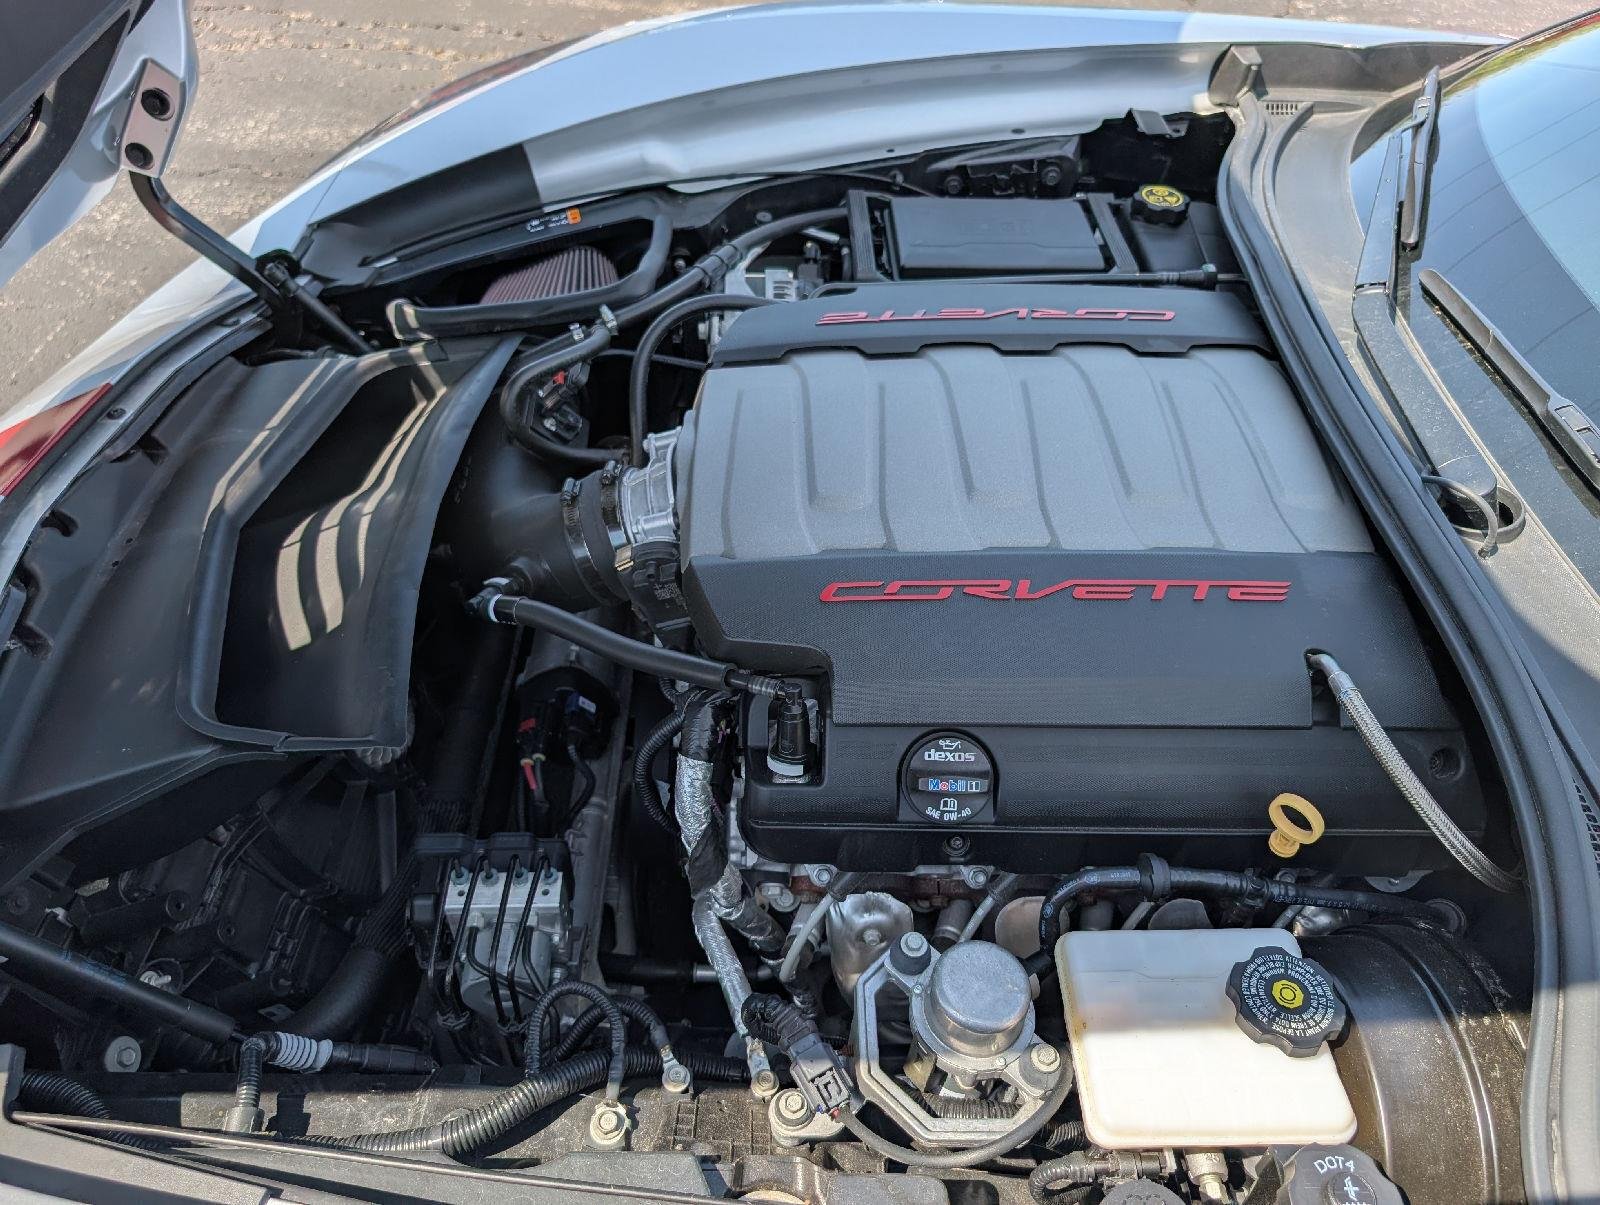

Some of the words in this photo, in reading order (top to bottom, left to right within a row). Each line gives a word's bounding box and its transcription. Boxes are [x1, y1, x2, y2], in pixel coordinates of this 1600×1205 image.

[815, 308, 1177, 325] CORVETTE
[819, 579, 1293, 603] CORVETTE
[924, 748, 977, 762] dexos
[928, 778, 966, 792] Mobil
[925, 806, 941, 820] SAE
